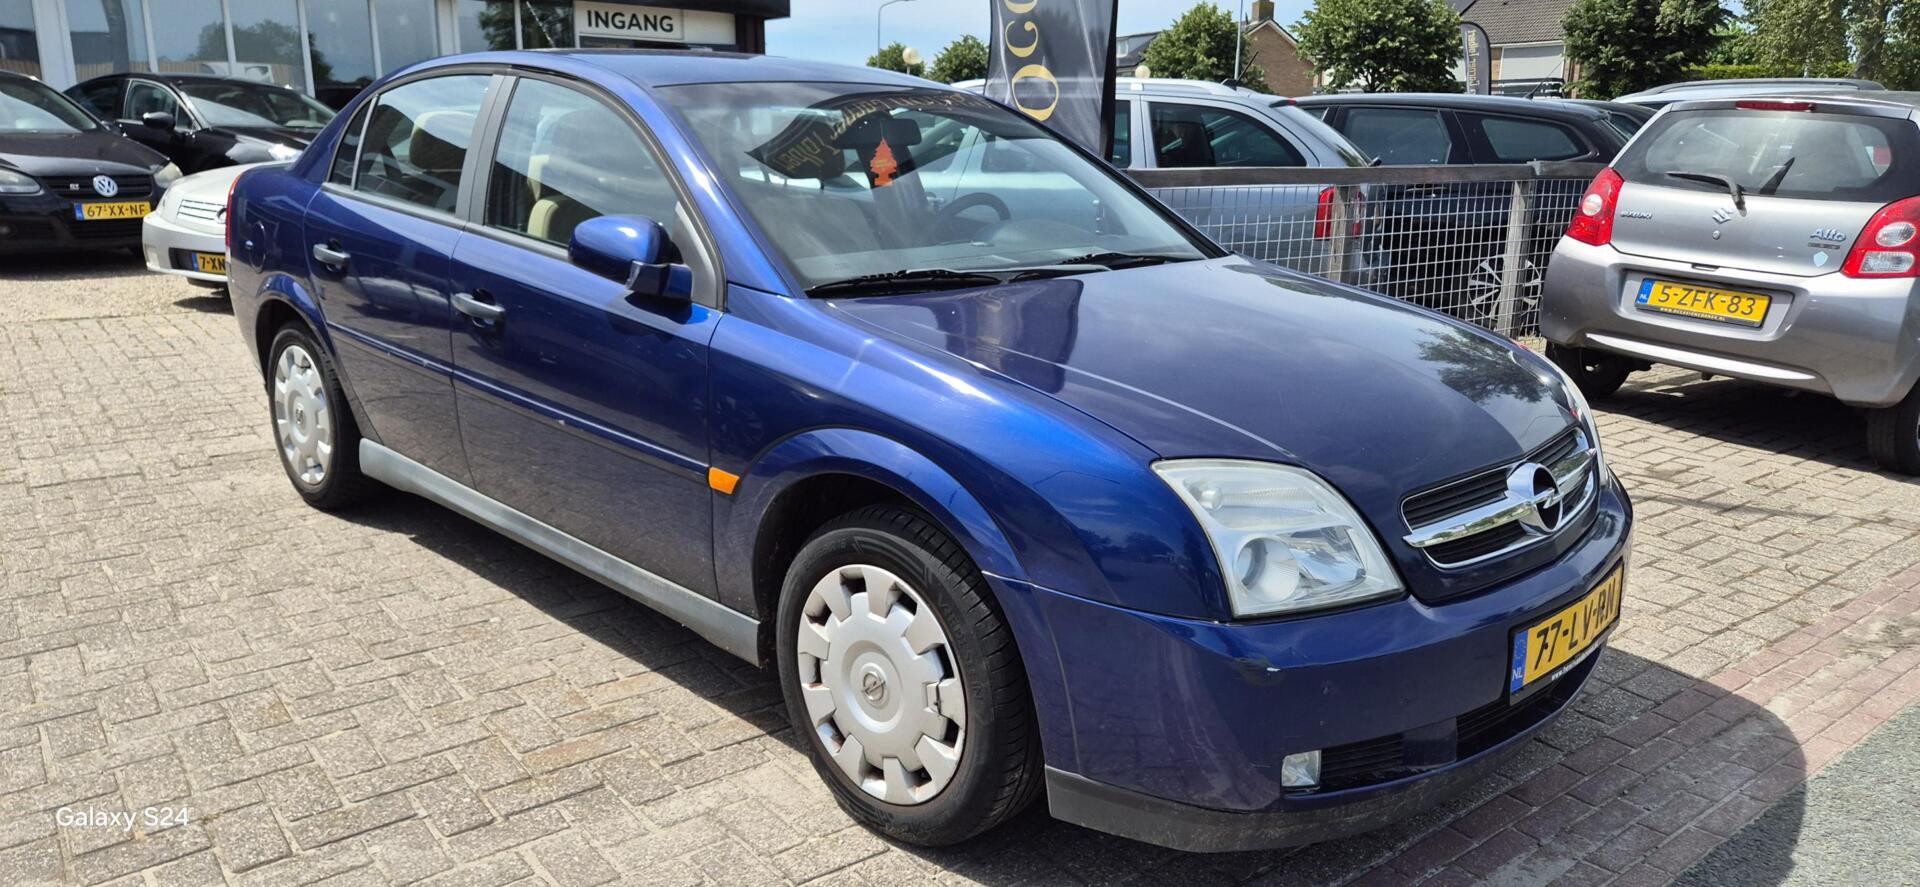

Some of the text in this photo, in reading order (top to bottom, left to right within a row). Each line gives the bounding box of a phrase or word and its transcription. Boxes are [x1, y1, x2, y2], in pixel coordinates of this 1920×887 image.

[587, 10, 674, 33] INGANG
[1810, 228, 1847, 242] Alto
[1657, 285, 1756, 316] 5-ZFK-83
[1512, 667, 1523, 680] NL
[1534, 577, 1617, 671] 77-LV-RN
